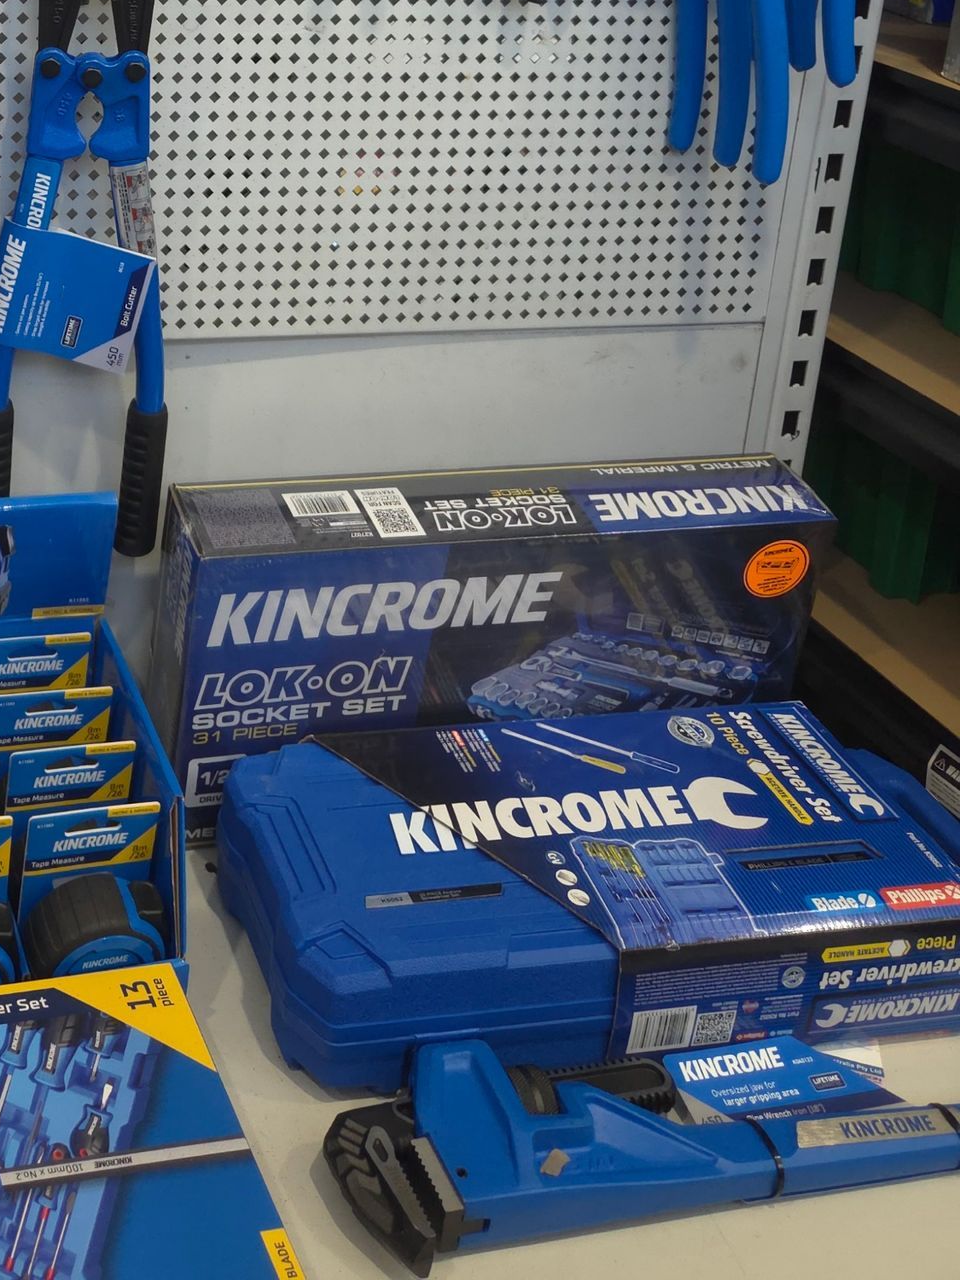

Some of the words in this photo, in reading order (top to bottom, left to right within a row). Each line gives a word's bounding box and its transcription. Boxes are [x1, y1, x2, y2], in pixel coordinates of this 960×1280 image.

[125, 286, 137, 310] Cutter
[120, 311, 131, 327] Bolt
[64, 319, 75, 345] LIFETIME
[106, 346, 119, 367] 450
[589, 465, 679, 475] IMPERIAL
[700, 460, 771, 471] METRIC
[423, 498, 468, 511] SET
[475, 494, 568, 507] SOCKET
[588, 484, 809, 522] KINCROME
[206, 570, 564, 649] KINCROME
[14, 714, 83, 730] KINCROME
[192, 702, 331, 731] SOCKET
[342, 695, 407, 715] SET
[192, 730, 221, 744] 31
[232, 723, 298, 741] PIECE
[705, 711, 725, 726] 10
[717, 726, 751, 756] Piece
[772, 713, 860, 796] KINCROME
[729, 711, 814, 794] Screwdriver
[805, 793, 842, 822] Set
[33, 770, 107, 788] KINCROME
[765, 777, 788, 798] ACETATE
[785, 795, 808, 821] HANDLE
[388, 786, 692, 856] KINCROME
[53, 833, 129, 852] KINCROME
[811, 896, 859, 912] Blade
[886, 885, 946, 905] Phillips
[917, 935, 956, 950] Piece
[82, 954, 129, 969] KINCROME
[126, 980, 157, 1011] 13
[161, 978, 175, 1007] piece
[16, 996, 49, 1013] Set
[845, 993, 960, 1024] KINCROME
[678, 1046, 784, 1083] KINCROME
[711, 1086, 750, 1099] Oversized
[750, 1084, 764, 1097] jaw
[764, 1081, 776, 1090] for
[812, 1075, 840, 1085] LIFETIME
[840, 1114, 937, 1139] KINCROME
[47, 1163, 84, 1175] 100mm
[94, 1156, 133, 1168] KINCROME
[16, 1170, 38, 1180] No.2
[273, 1240, 299, 1279] BLADE
